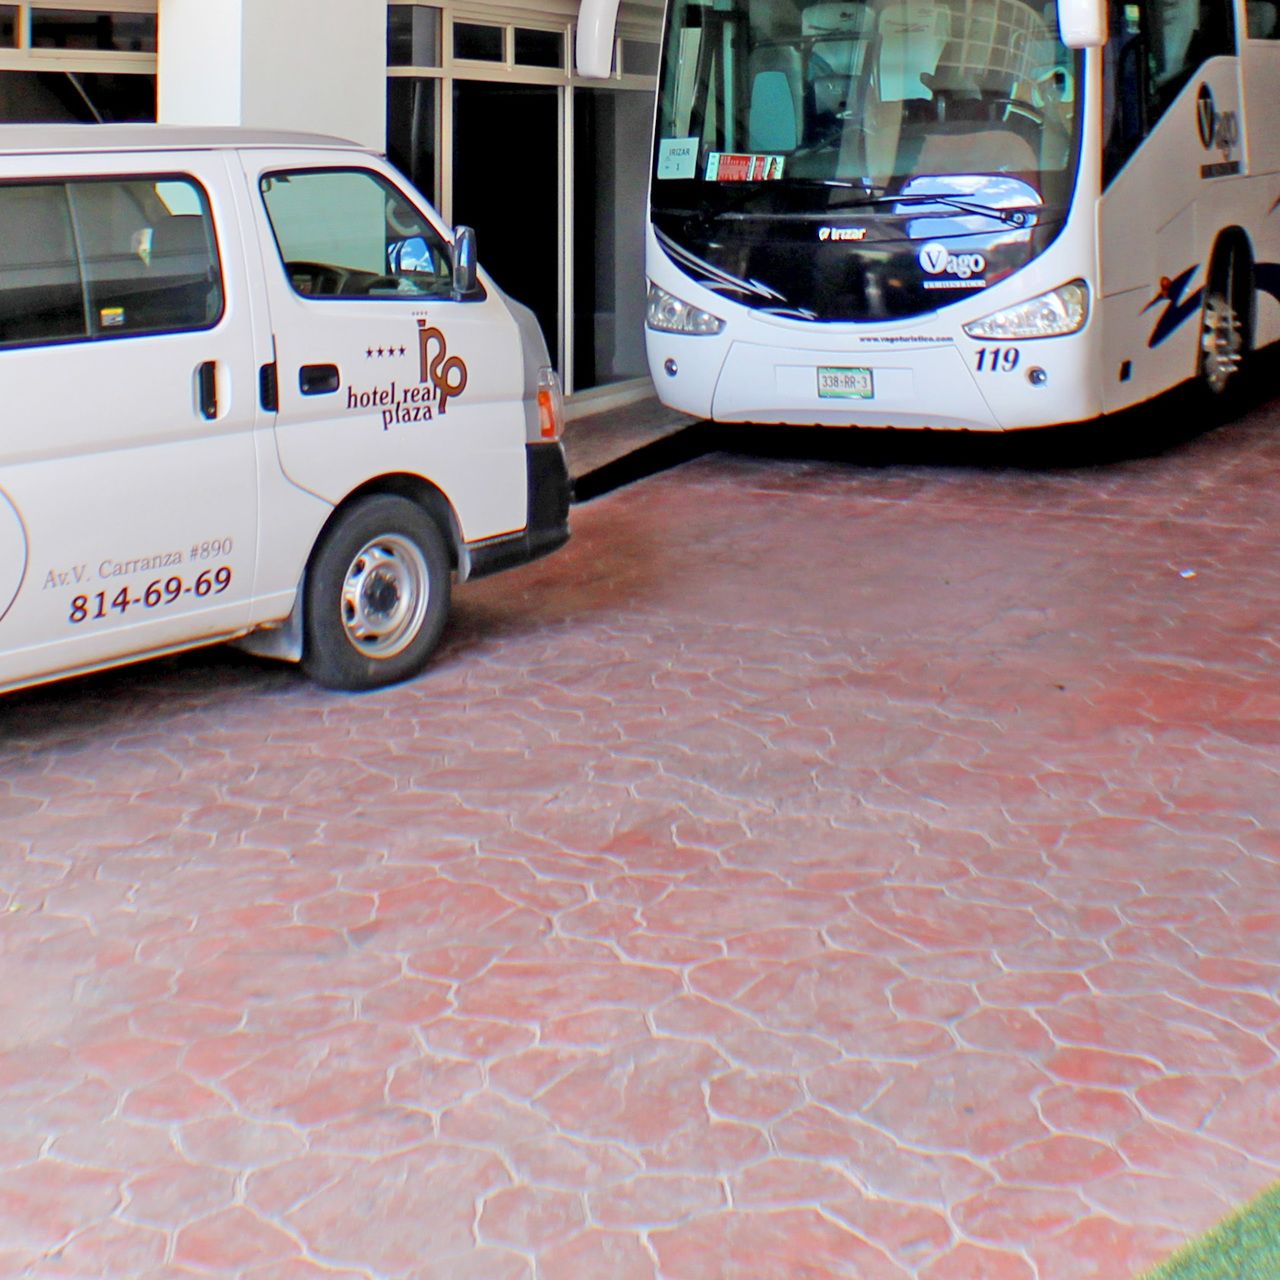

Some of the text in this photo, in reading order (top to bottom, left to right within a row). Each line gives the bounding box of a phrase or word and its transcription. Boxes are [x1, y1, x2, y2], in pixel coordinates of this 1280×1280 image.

[921, 243, 986, 278] Vago
[974, 347, 1020, 372] 119
[347, 381, 437, 409] hotel real
[382, 401, 433, 431] plaza
[98, 550, 183, 580] Carranza
[189, 536, 234, 561] #890
[68, 565, 233, 624] 814-69-69
